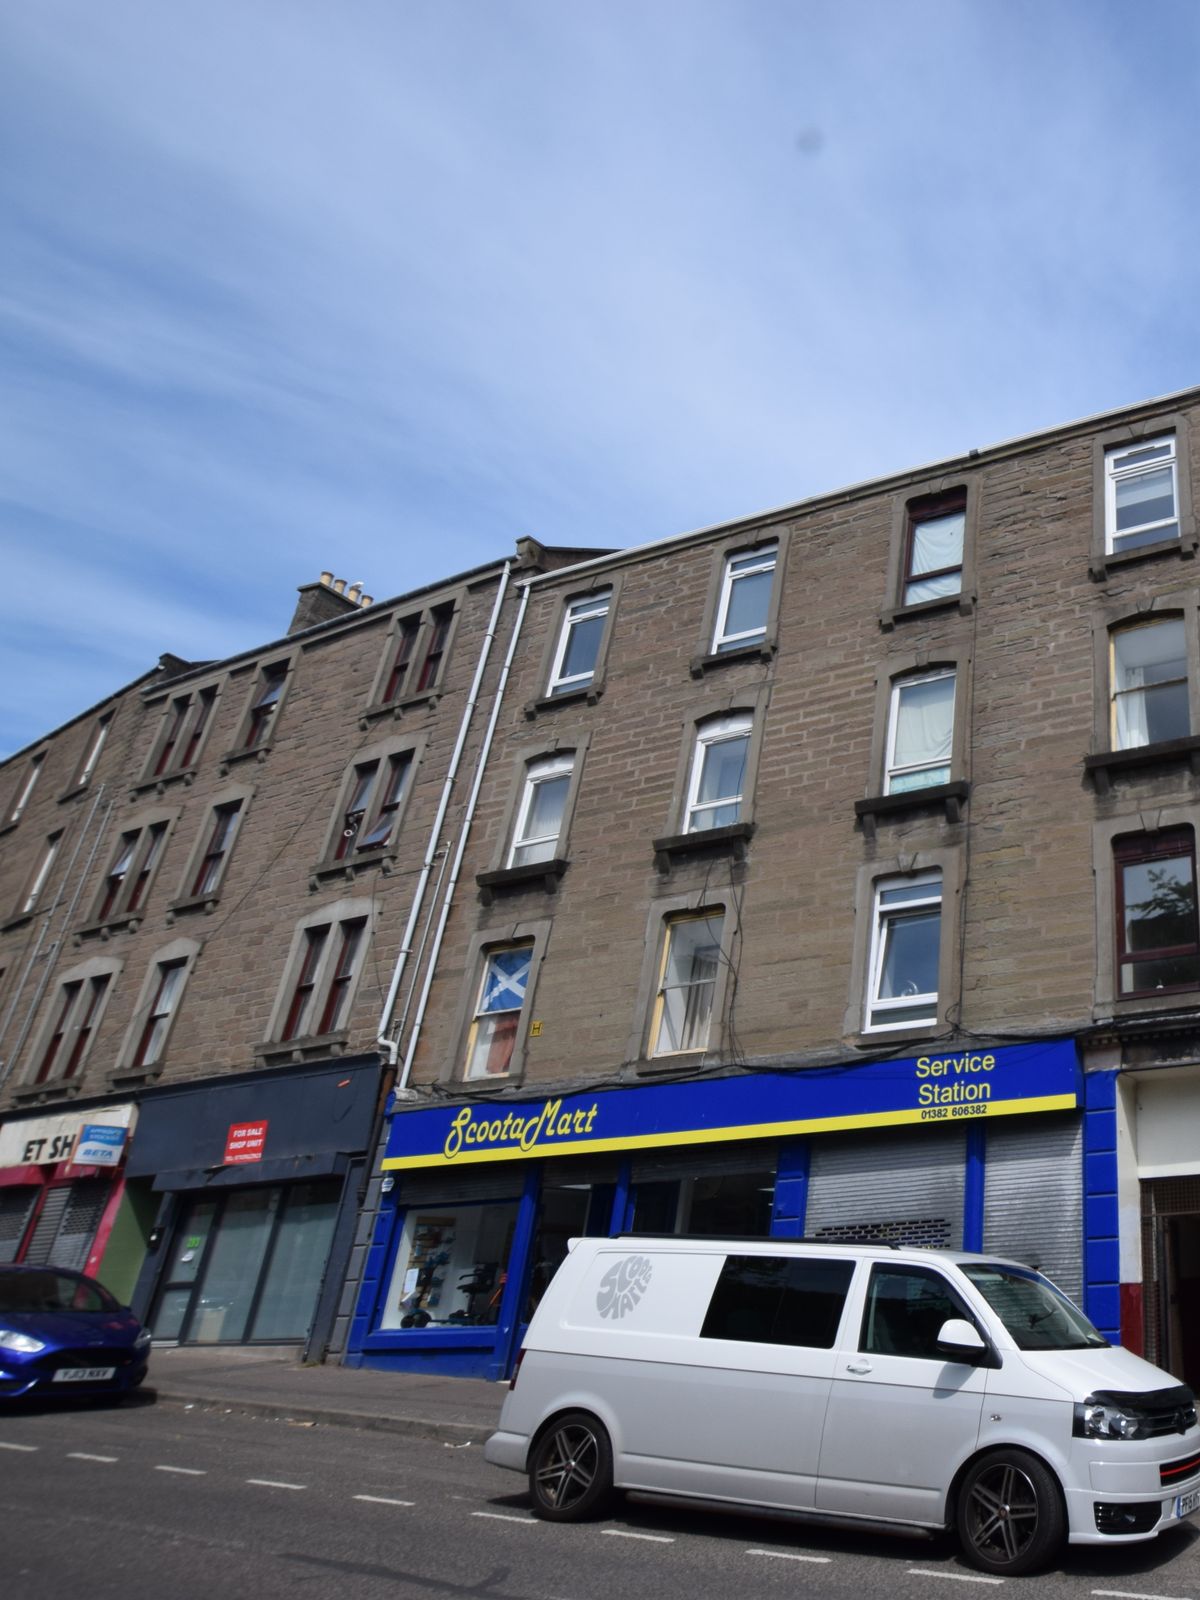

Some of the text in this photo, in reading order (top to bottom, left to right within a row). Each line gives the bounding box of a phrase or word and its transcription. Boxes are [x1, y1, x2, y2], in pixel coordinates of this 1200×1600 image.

[531, 1022, 542, 1035] H
[916, 1053, 995, 1078] Service
[918, 1081, 991, 1105] Station
[921, 1104, 987, 1119] 01382 606382
[233, 1128, 263, 1137] FOR SALE
[22, 1138, 48, 1162] ET
[229, 1139, 263, 1150] SHOP UNIT
[83, 1149, 113, 1158] BETA
